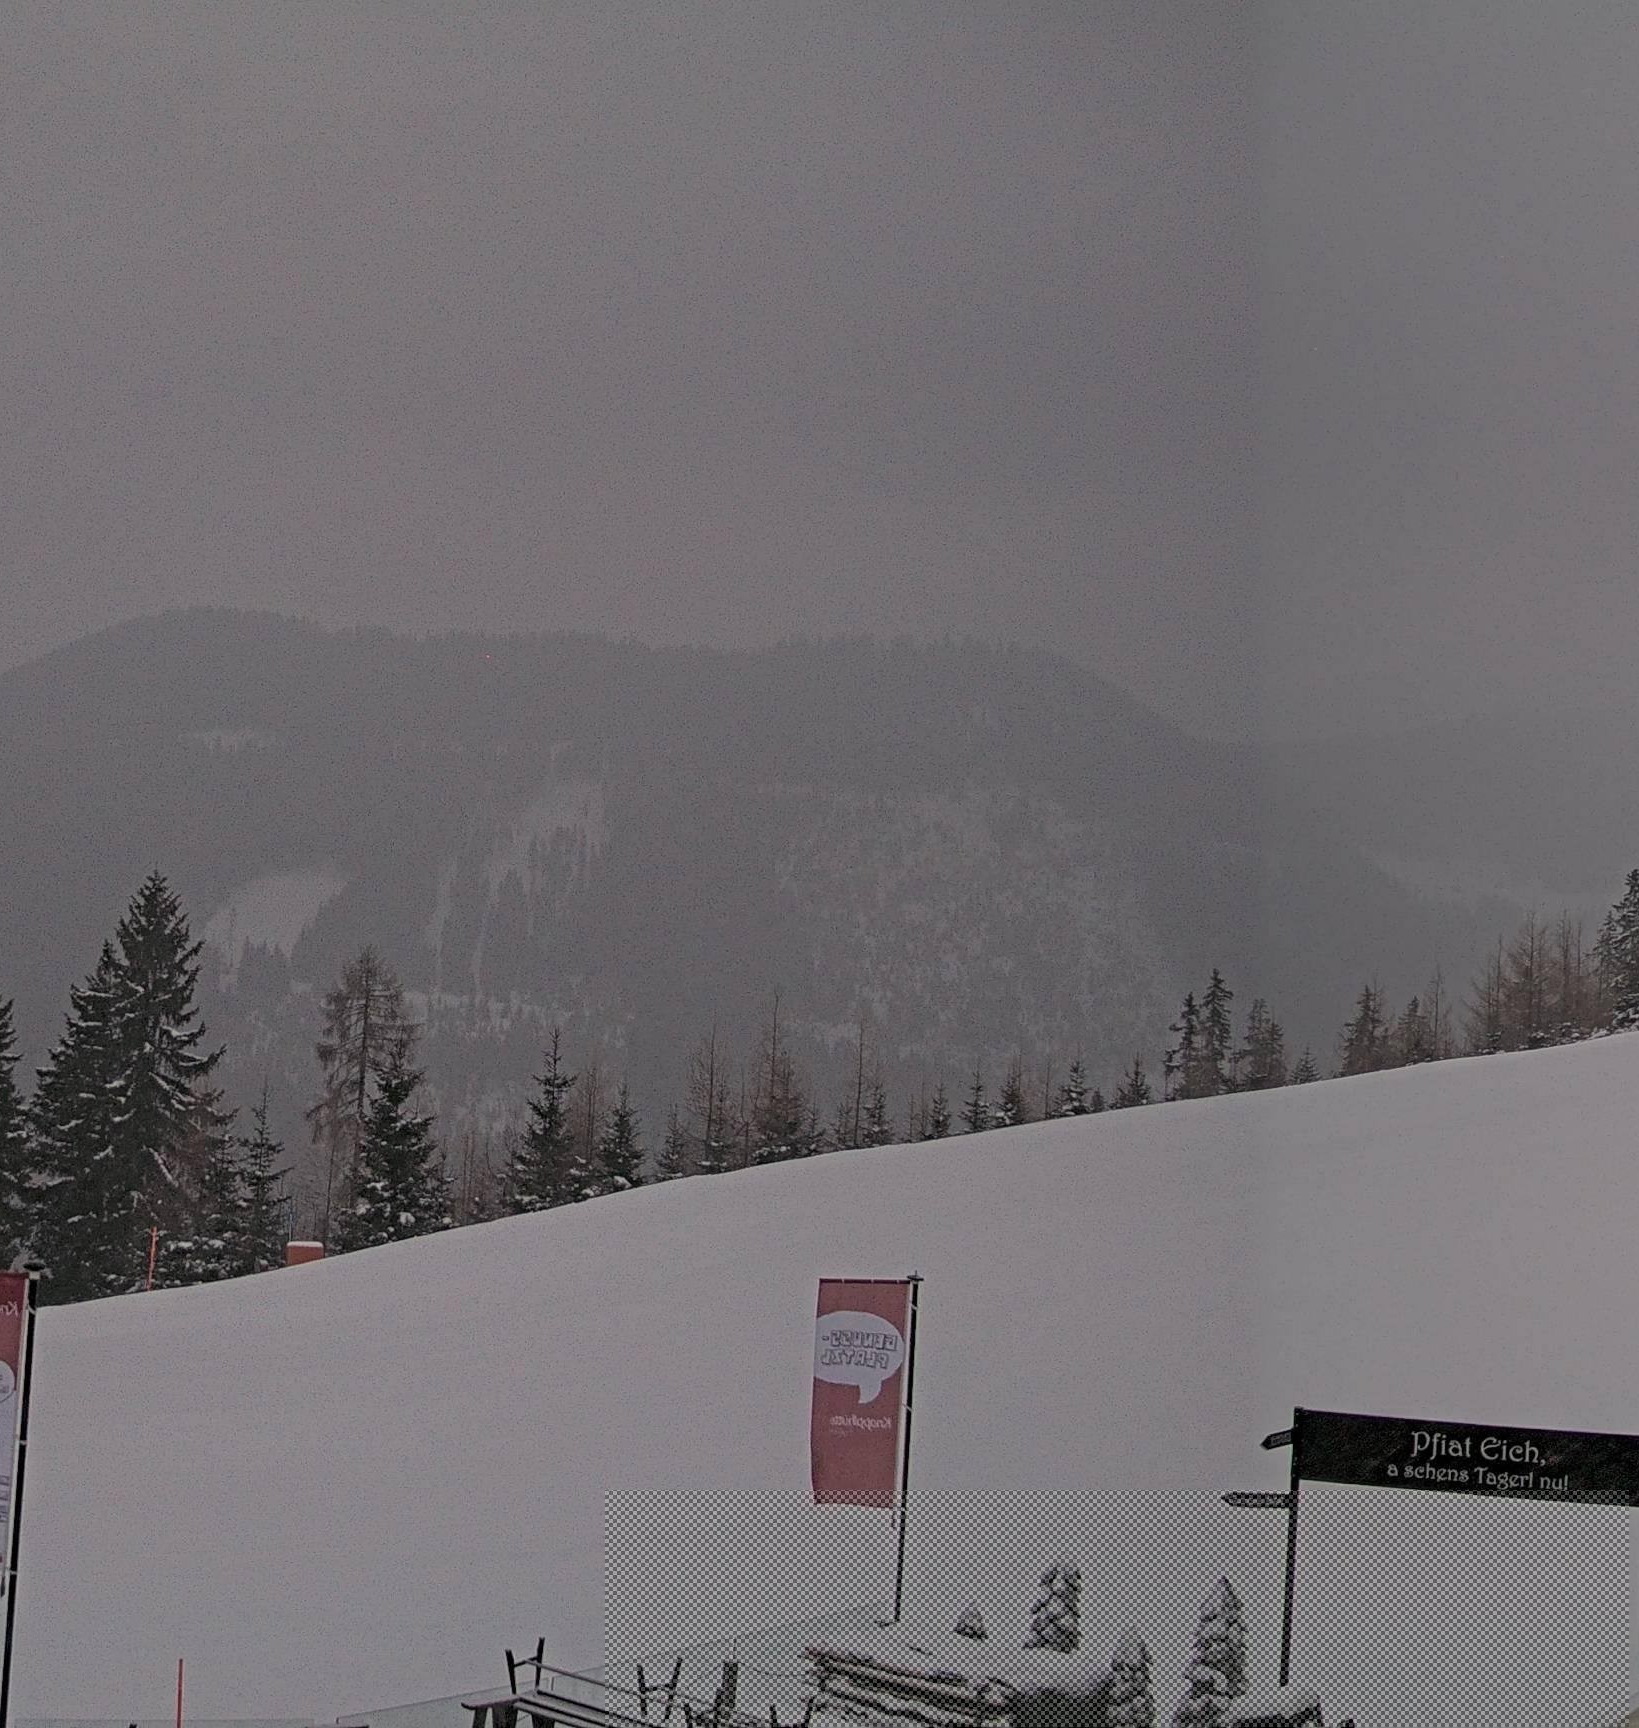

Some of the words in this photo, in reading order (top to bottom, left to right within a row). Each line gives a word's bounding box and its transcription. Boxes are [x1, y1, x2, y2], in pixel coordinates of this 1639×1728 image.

[1410, 1431, 1472, 1460] Pfiat
[1480, 1436, 1547, 1467] Eich,
[1387, 1464, 1399, 1477] a
[1404, 1463, 1470, 1483] schens
[1474, 1467, 1534, 1490] Tagerl
[1539, 1475, 1570, 1491] nu!
